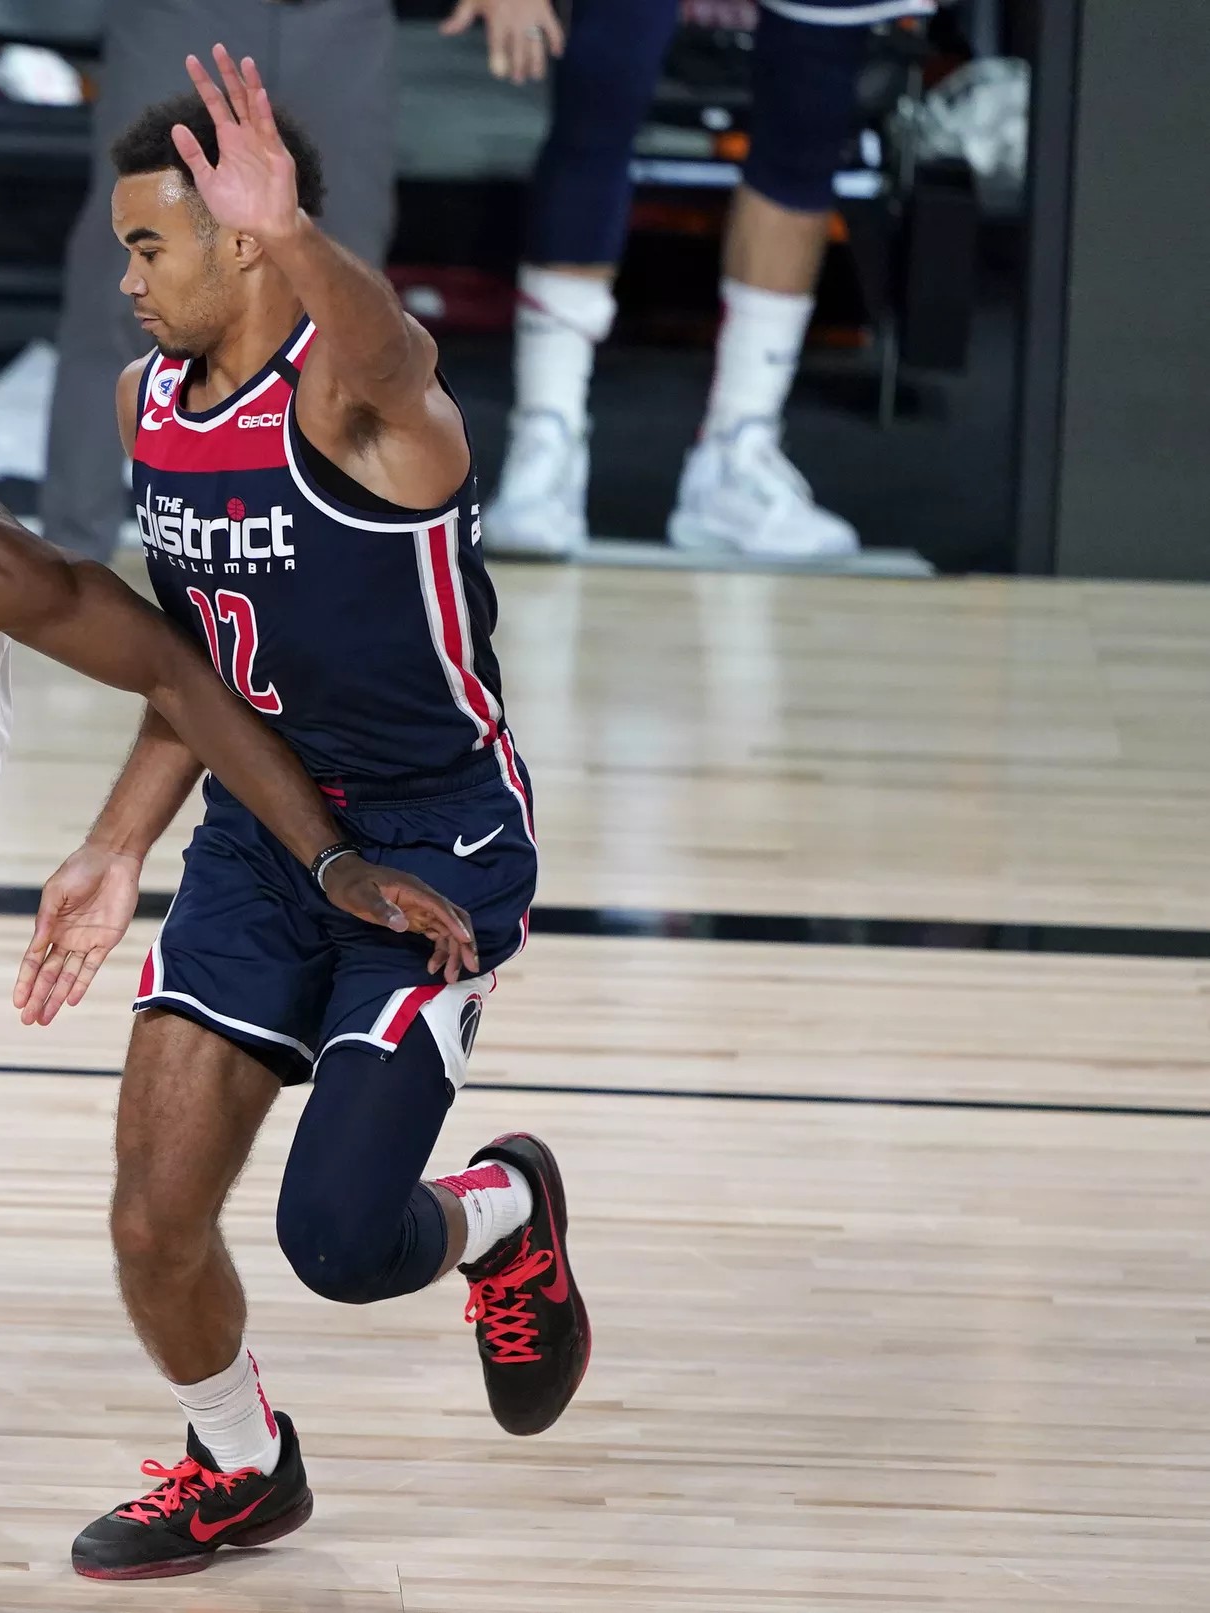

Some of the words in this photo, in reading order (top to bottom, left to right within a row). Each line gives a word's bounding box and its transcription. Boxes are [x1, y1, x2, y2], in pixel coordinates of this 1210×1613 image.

[155, 495, 184, 514] THE
[135, 482, 295, 560] district
[143, 545, 159, 561] OF
[167, 555, 296, 575] COLUMBIA
